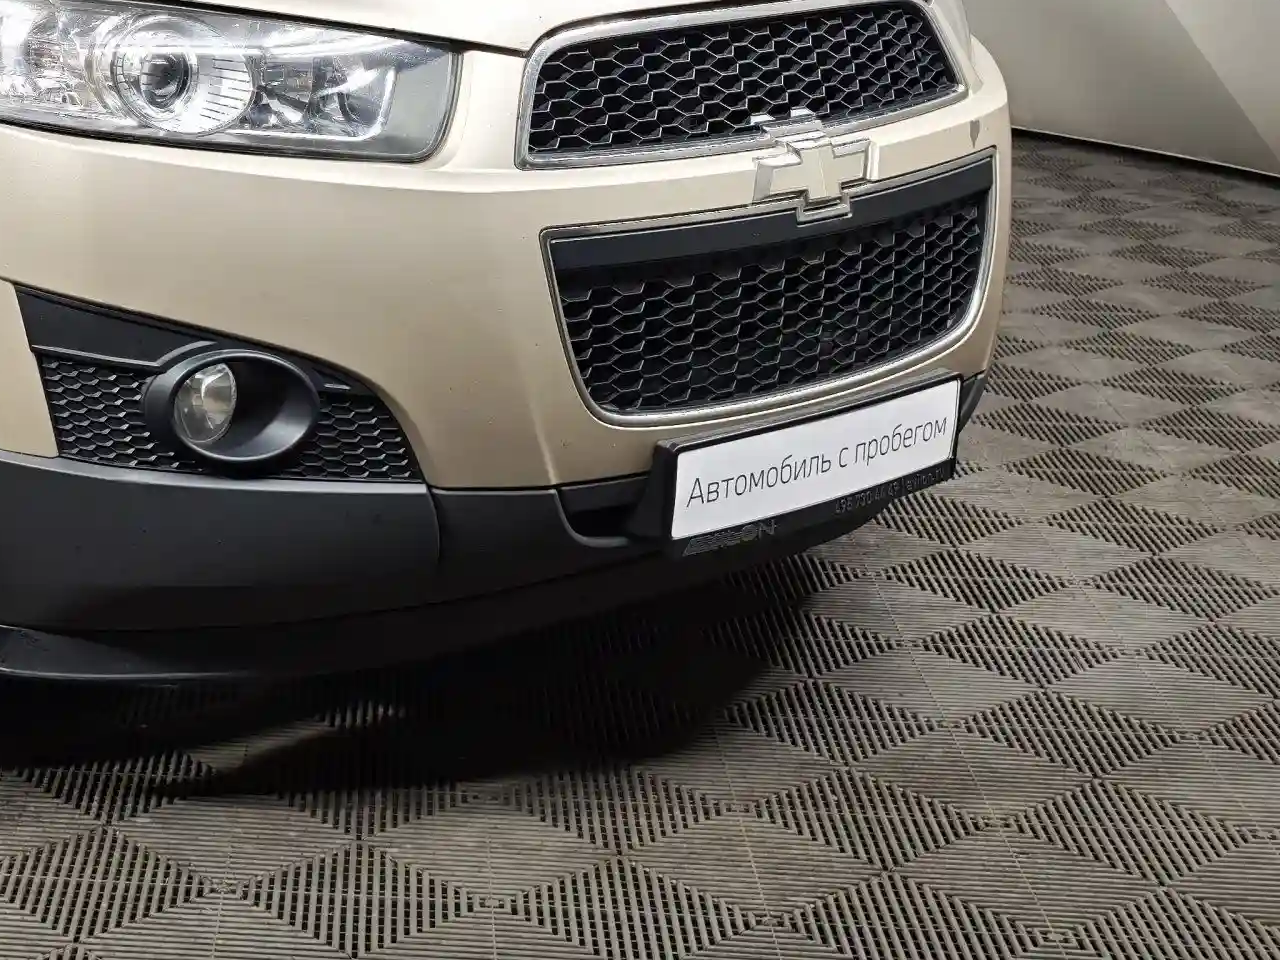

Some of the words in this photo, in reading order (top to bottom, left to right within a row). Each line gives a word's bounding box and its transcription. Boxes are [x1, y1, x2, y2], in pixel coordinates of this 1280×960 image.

[686, 454, 832, 508] Автомобиль
[838, 447, 849, 468] с
[854, 417, 948, 466] пробегом
